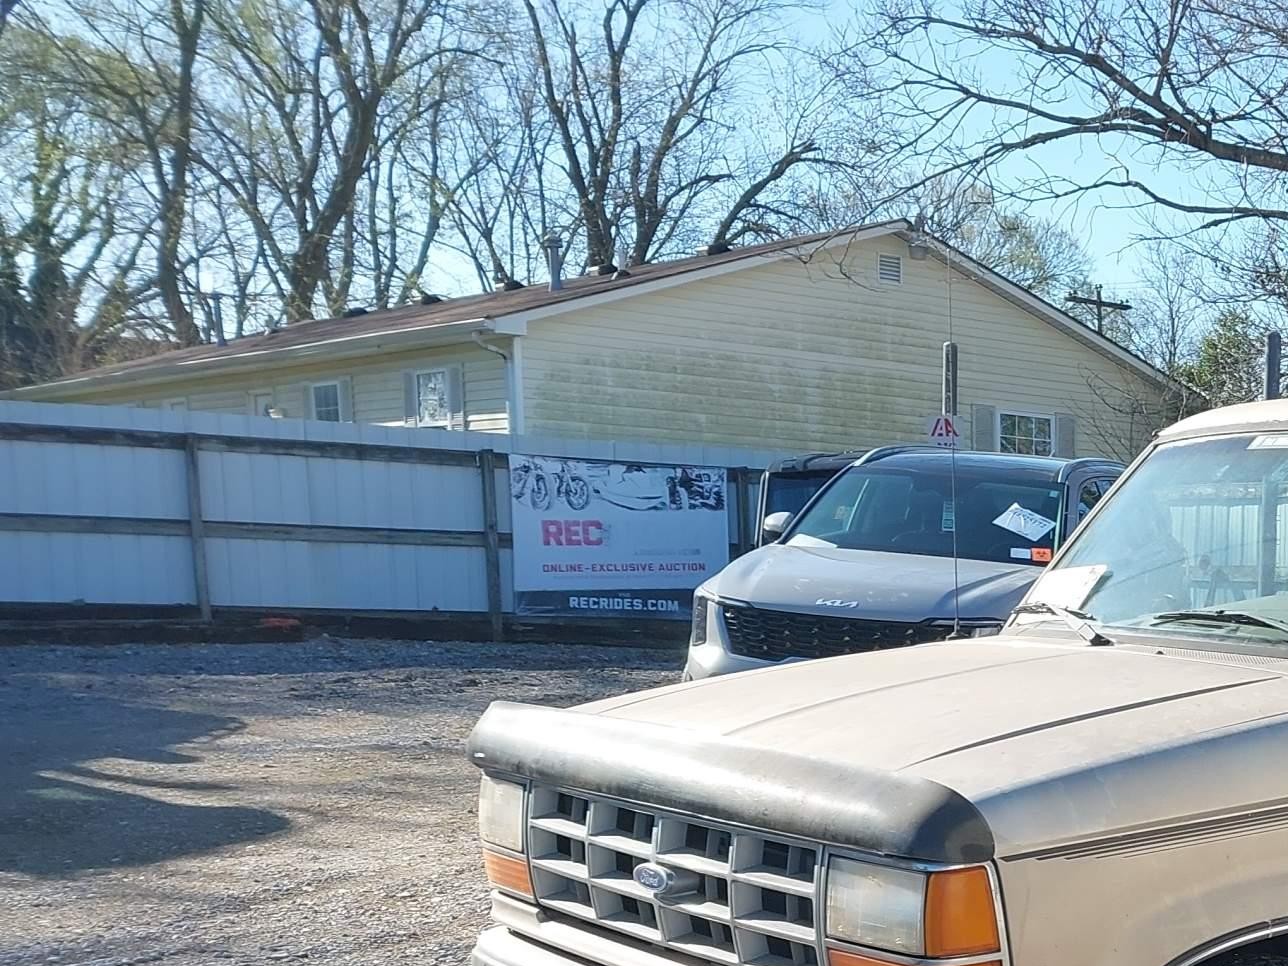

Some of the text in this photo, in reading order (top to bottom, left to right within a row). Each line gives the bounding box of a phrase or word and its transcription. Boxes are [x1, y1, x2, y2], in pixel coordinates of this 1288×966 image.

[542, 519, 604, 546] REC
[542, 563, 706, 573] ONLINE-EXCLUSIVE AUCTION
[569, 596, 679, 612] RECRIDES.COM
